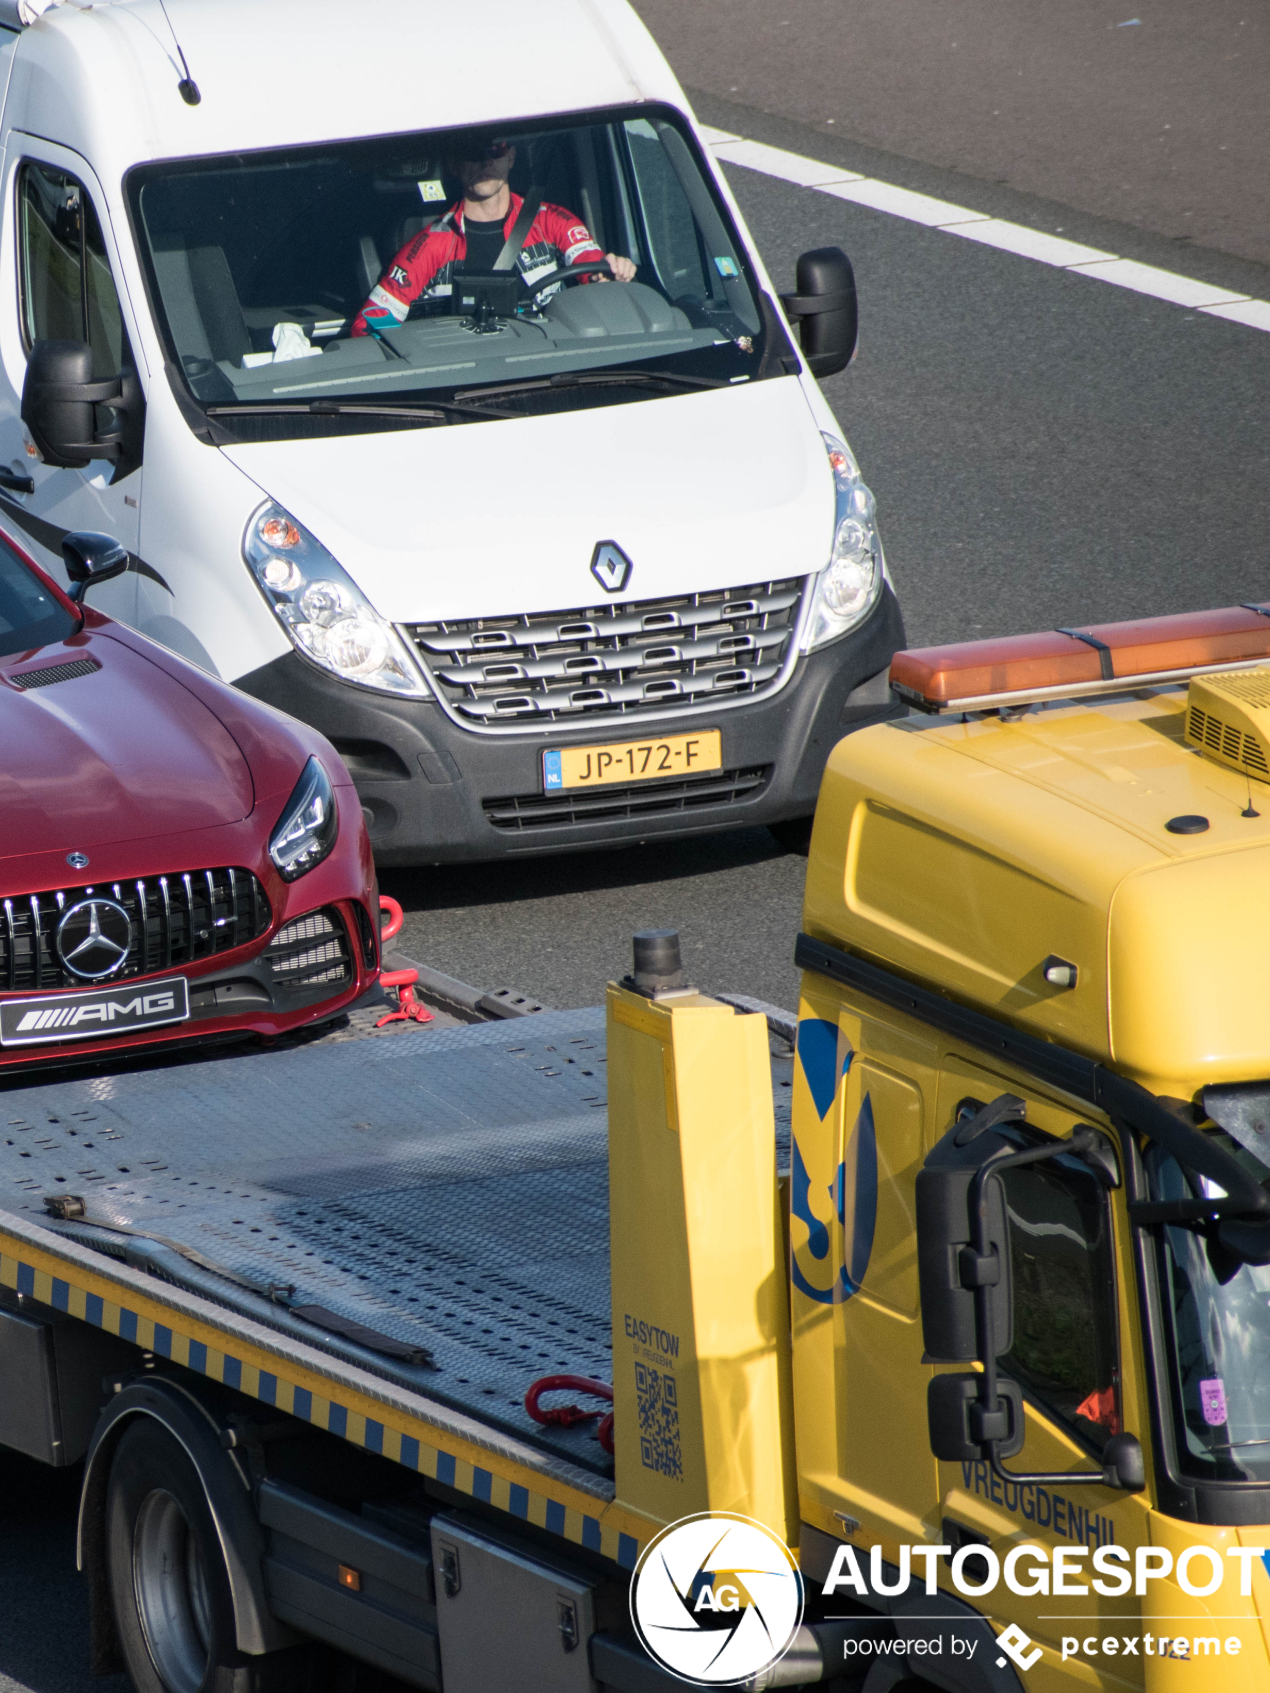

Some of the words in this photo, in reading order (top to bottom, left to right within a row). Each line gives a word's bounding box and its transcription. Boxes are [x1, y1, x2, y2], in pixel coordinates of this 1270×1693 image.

[547, 773, 561, 784] NL
[579, 740, 700, 780] JP-172-F
[69, 991, 175, 1025] AMG
[624, 1313, 679, 1358] EASYTOW
